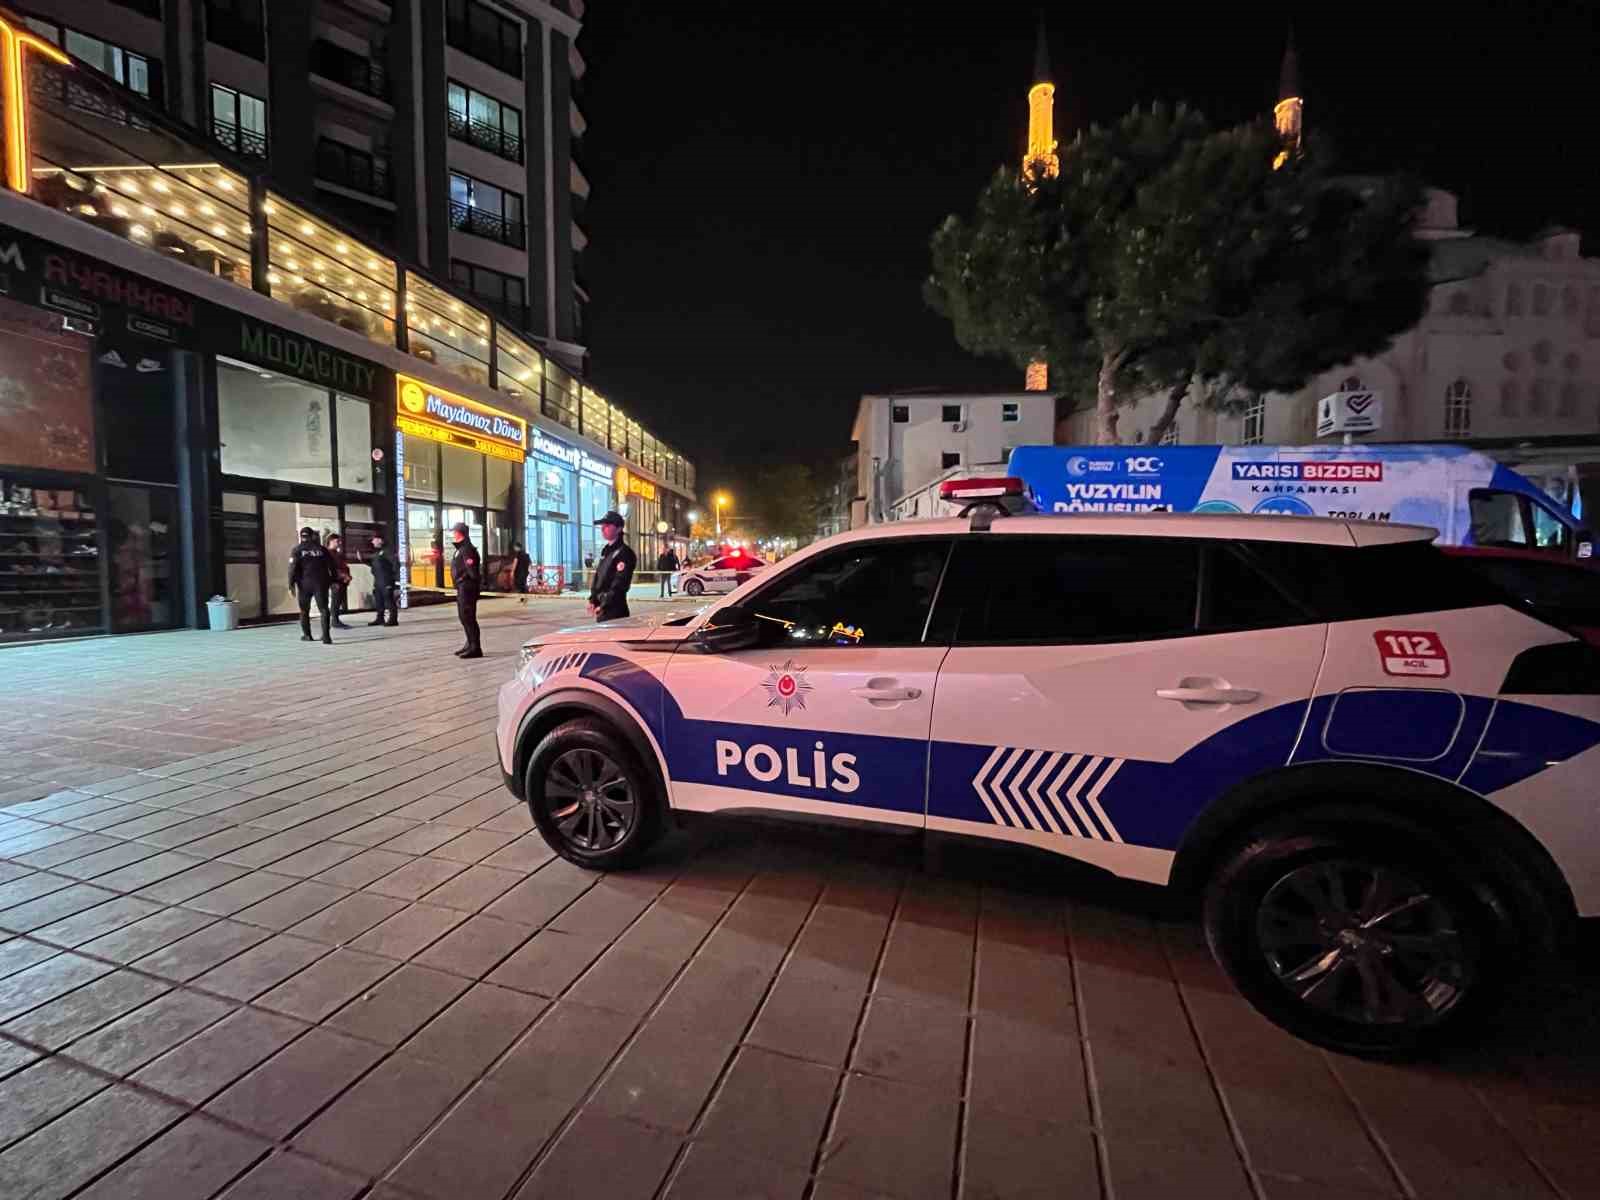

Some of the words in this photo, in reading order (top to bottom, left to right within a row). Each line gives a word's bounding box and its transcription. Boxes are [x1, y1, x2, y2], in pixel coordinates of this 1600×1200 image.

[426, 394, 491, 435] Maydonoz
[1235, 464, 1298, 478] YARISI
[1251, 485, 1357, 494] KAMPANYASI
[1384, 635, 1437, 655] 112
[716, 739, 860, 793] POLİS
